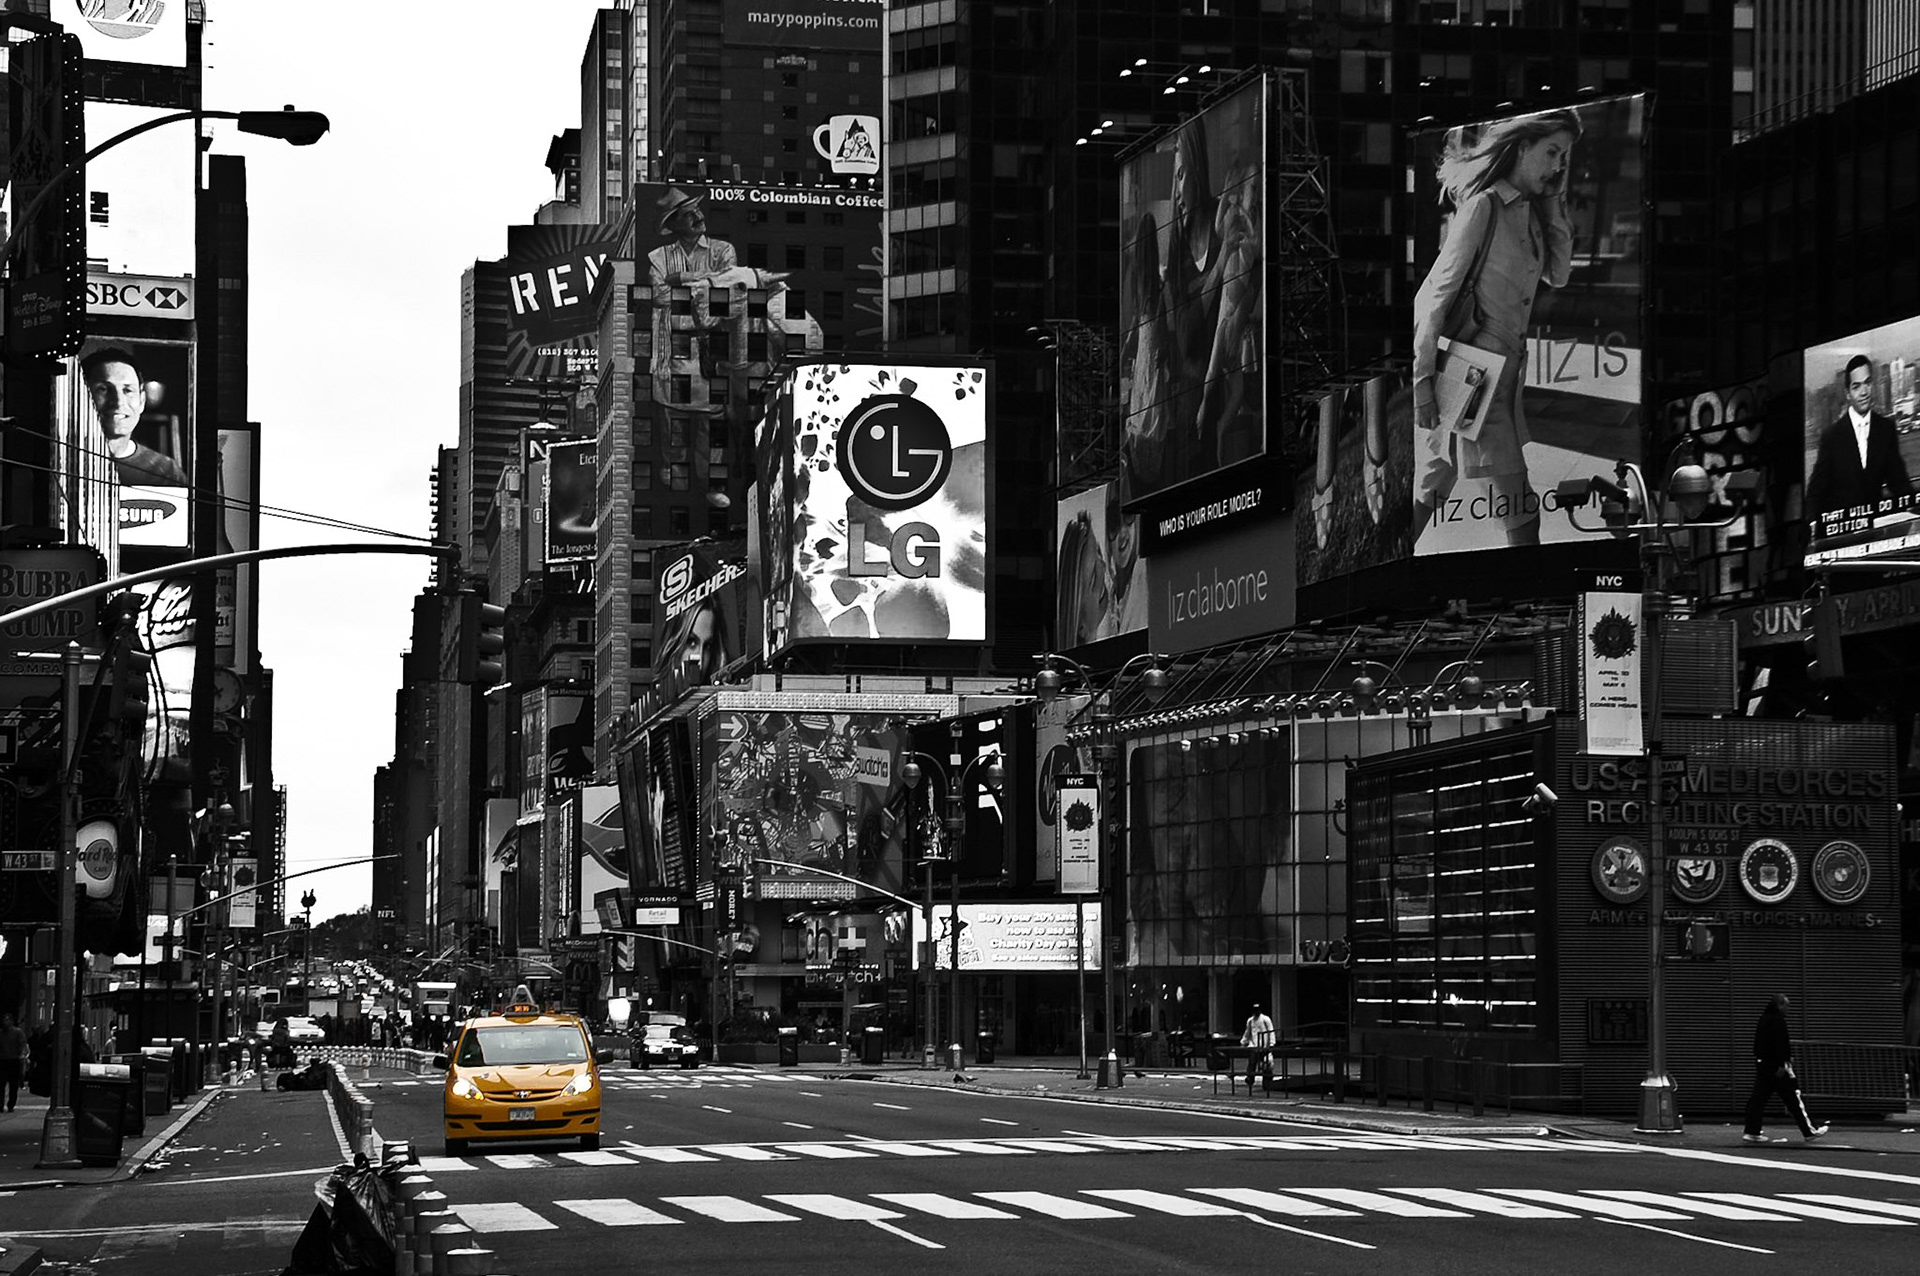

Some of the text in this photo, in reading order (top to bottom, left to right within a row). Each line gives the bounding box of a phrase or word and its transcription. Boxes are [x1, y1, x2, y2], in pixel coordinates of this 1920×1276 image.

[747, 11, 879, 29] marypoppins.com
[709, 188, 885, 208] 100% Colombian Coffee
[1535, 322, 1579, 385] liz
[1159, 487, 1262, 538] WHO IS YOUR ROLE MODEL?
[1433, 490, 1463, 528] liz
[1821, 495, 1910, 523] THAT WILL DO IT
[1826, 518, 1869, 536] EDITION
[848, 521, 940, 578] LG
[1595, 576, 1623, 587] NYC
[1187, 567, 1269, 620] claiborne
[1066, 777, 1084, 786] NYC
[1757, 766, 1888, 798] FORCES
[1587, 800, 1871, 828] RECUITING STATION
[1668, 829, 1696, 840] ADOLPH
[1679, 843, 1728, 853] W 43 ST
[4, 853, 38, 868] W 43 ST
[377, 910, 395, 919] NFL
[978, 912, 1003, 924] Buy
[1005, 914, 1032, 924] your
[1589, 910, 1633, 923] ARMY
[1006, 927, 1033, 936] now
[1033, 927, 1045, 936] to
[990, 938, 1033, 950] Charity
[1035, 938, 1057, 950] Day
